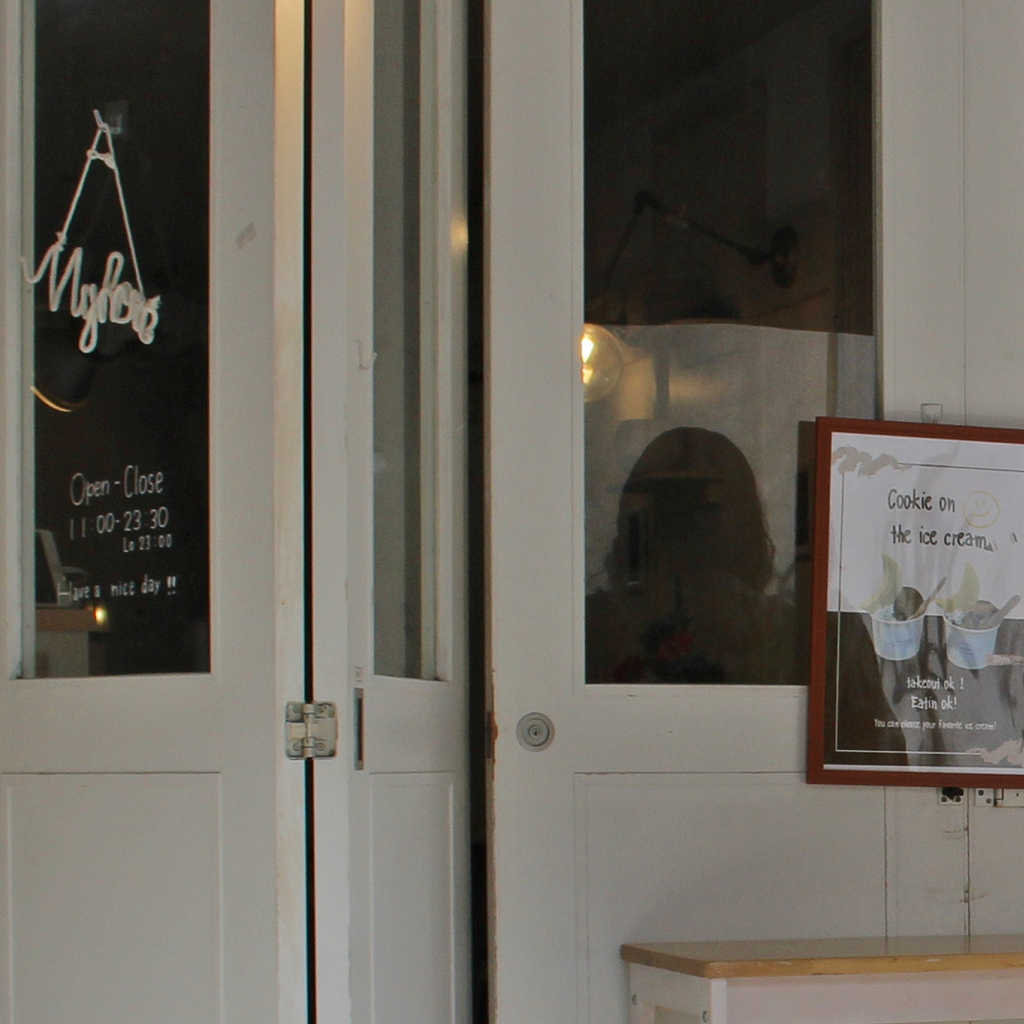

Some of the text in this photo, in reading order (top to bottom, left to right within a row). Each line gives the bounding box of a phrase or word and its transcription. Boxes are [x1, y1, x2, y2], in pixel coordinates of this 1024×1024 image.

[70, 473, 110, 505] Open
[123, 465, 164, 498] Close
[888, 489, 955, 513] Cookie on
[890, 525, 911, 545] the
[919, 526, 938, 545] ice
[141, 574, 160, 596] day
